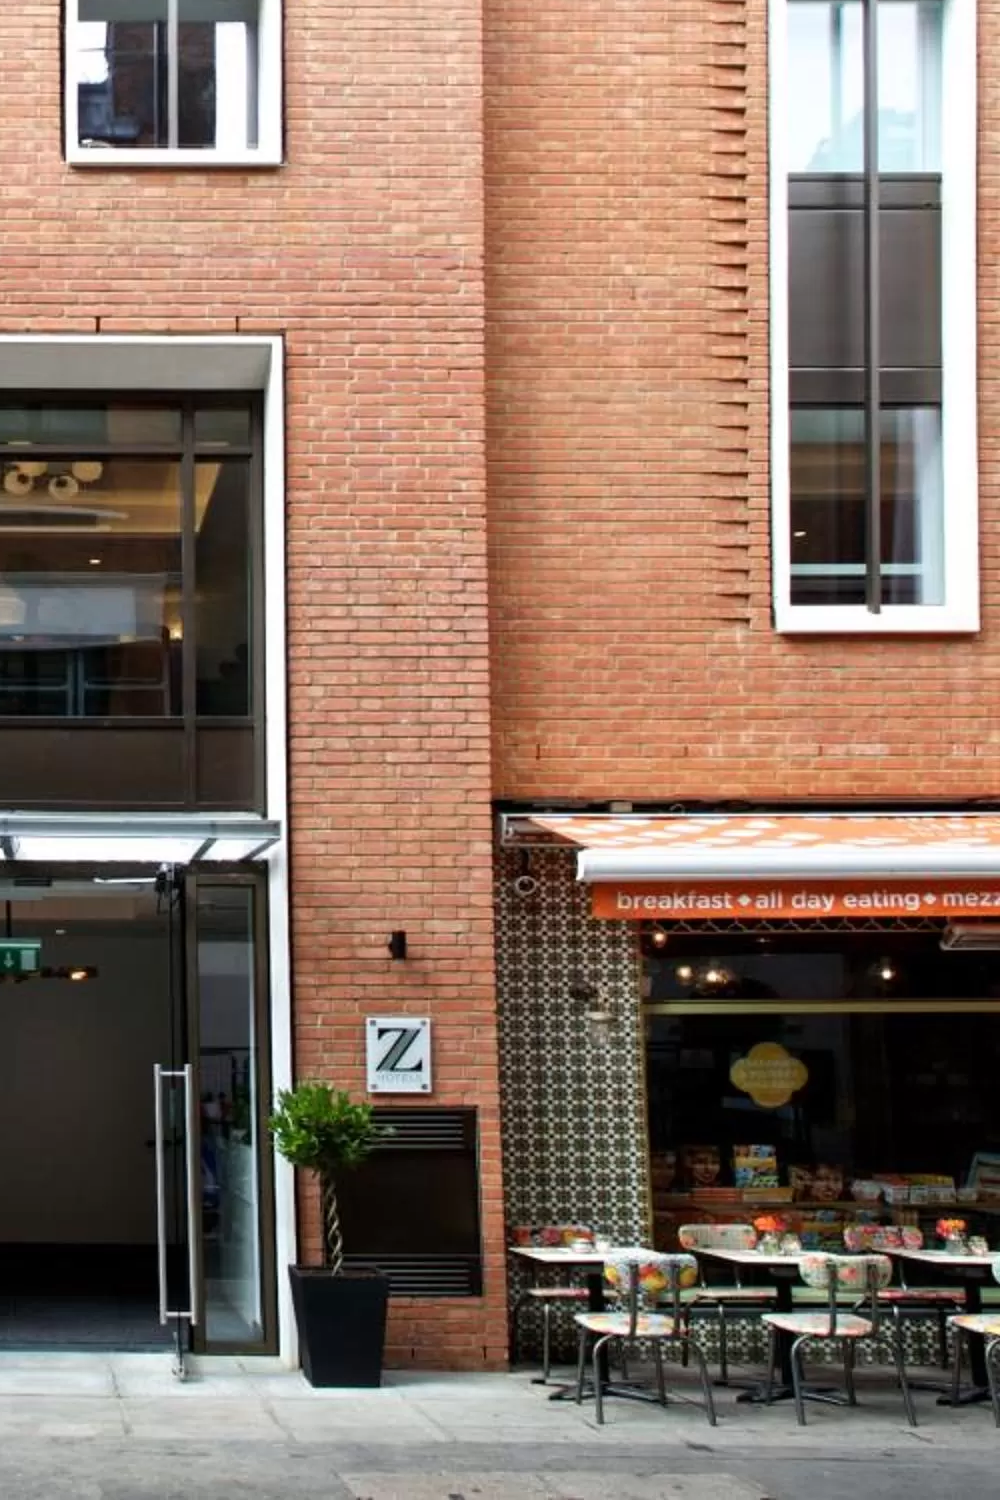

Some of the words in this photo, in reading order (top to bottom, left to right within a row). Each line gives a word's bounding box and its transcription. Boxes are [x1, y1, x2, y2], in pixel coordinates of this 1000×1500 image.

[616, 891, 734, 910] breakfast
[755, 891, 783, 909] all
[791, 890, 834, 912] day
[843, 890, 921, 912] eating
[376, 1028, 422, 1071] Z
